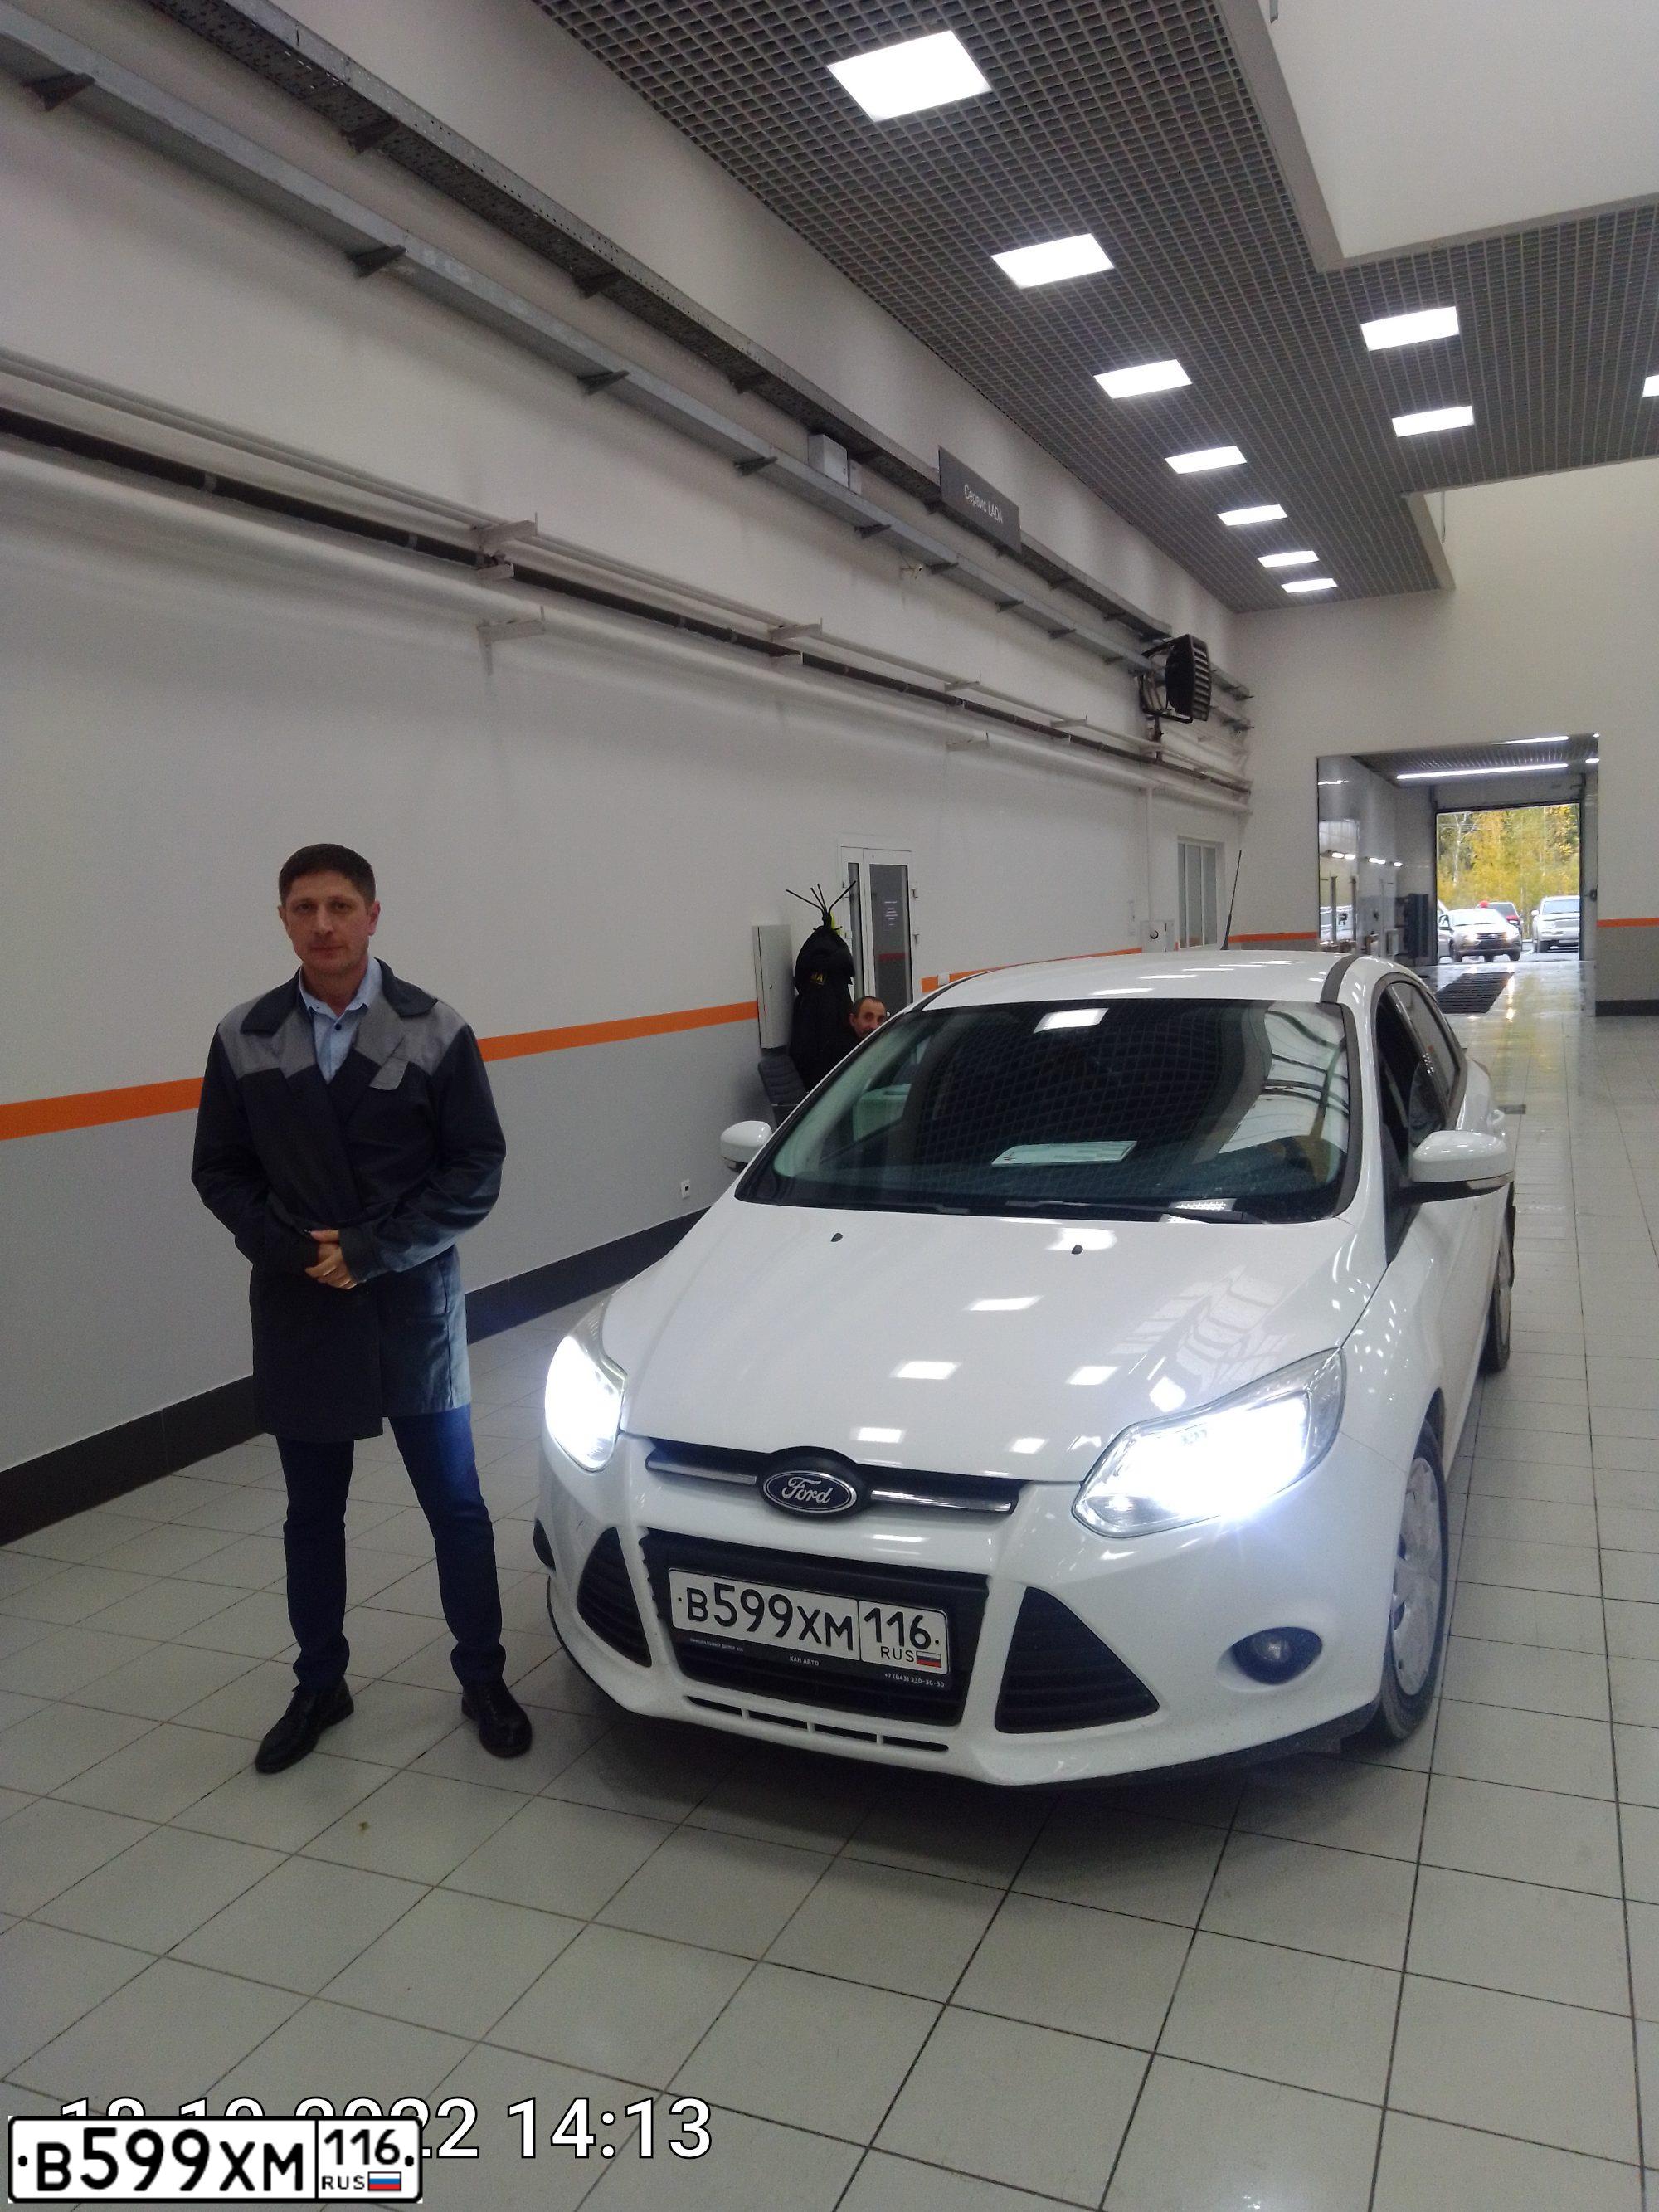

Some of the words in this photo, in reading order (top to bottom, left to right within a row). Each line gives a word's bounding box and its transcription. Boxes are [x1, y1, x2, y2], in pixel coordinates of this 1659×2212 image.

[987, 501, 1003, 524] LADA
[781, 1476, 833, 1504] Ford
[864, 1607, 931, 1650] 116
[880, 1645, 915, 1663] RUS
